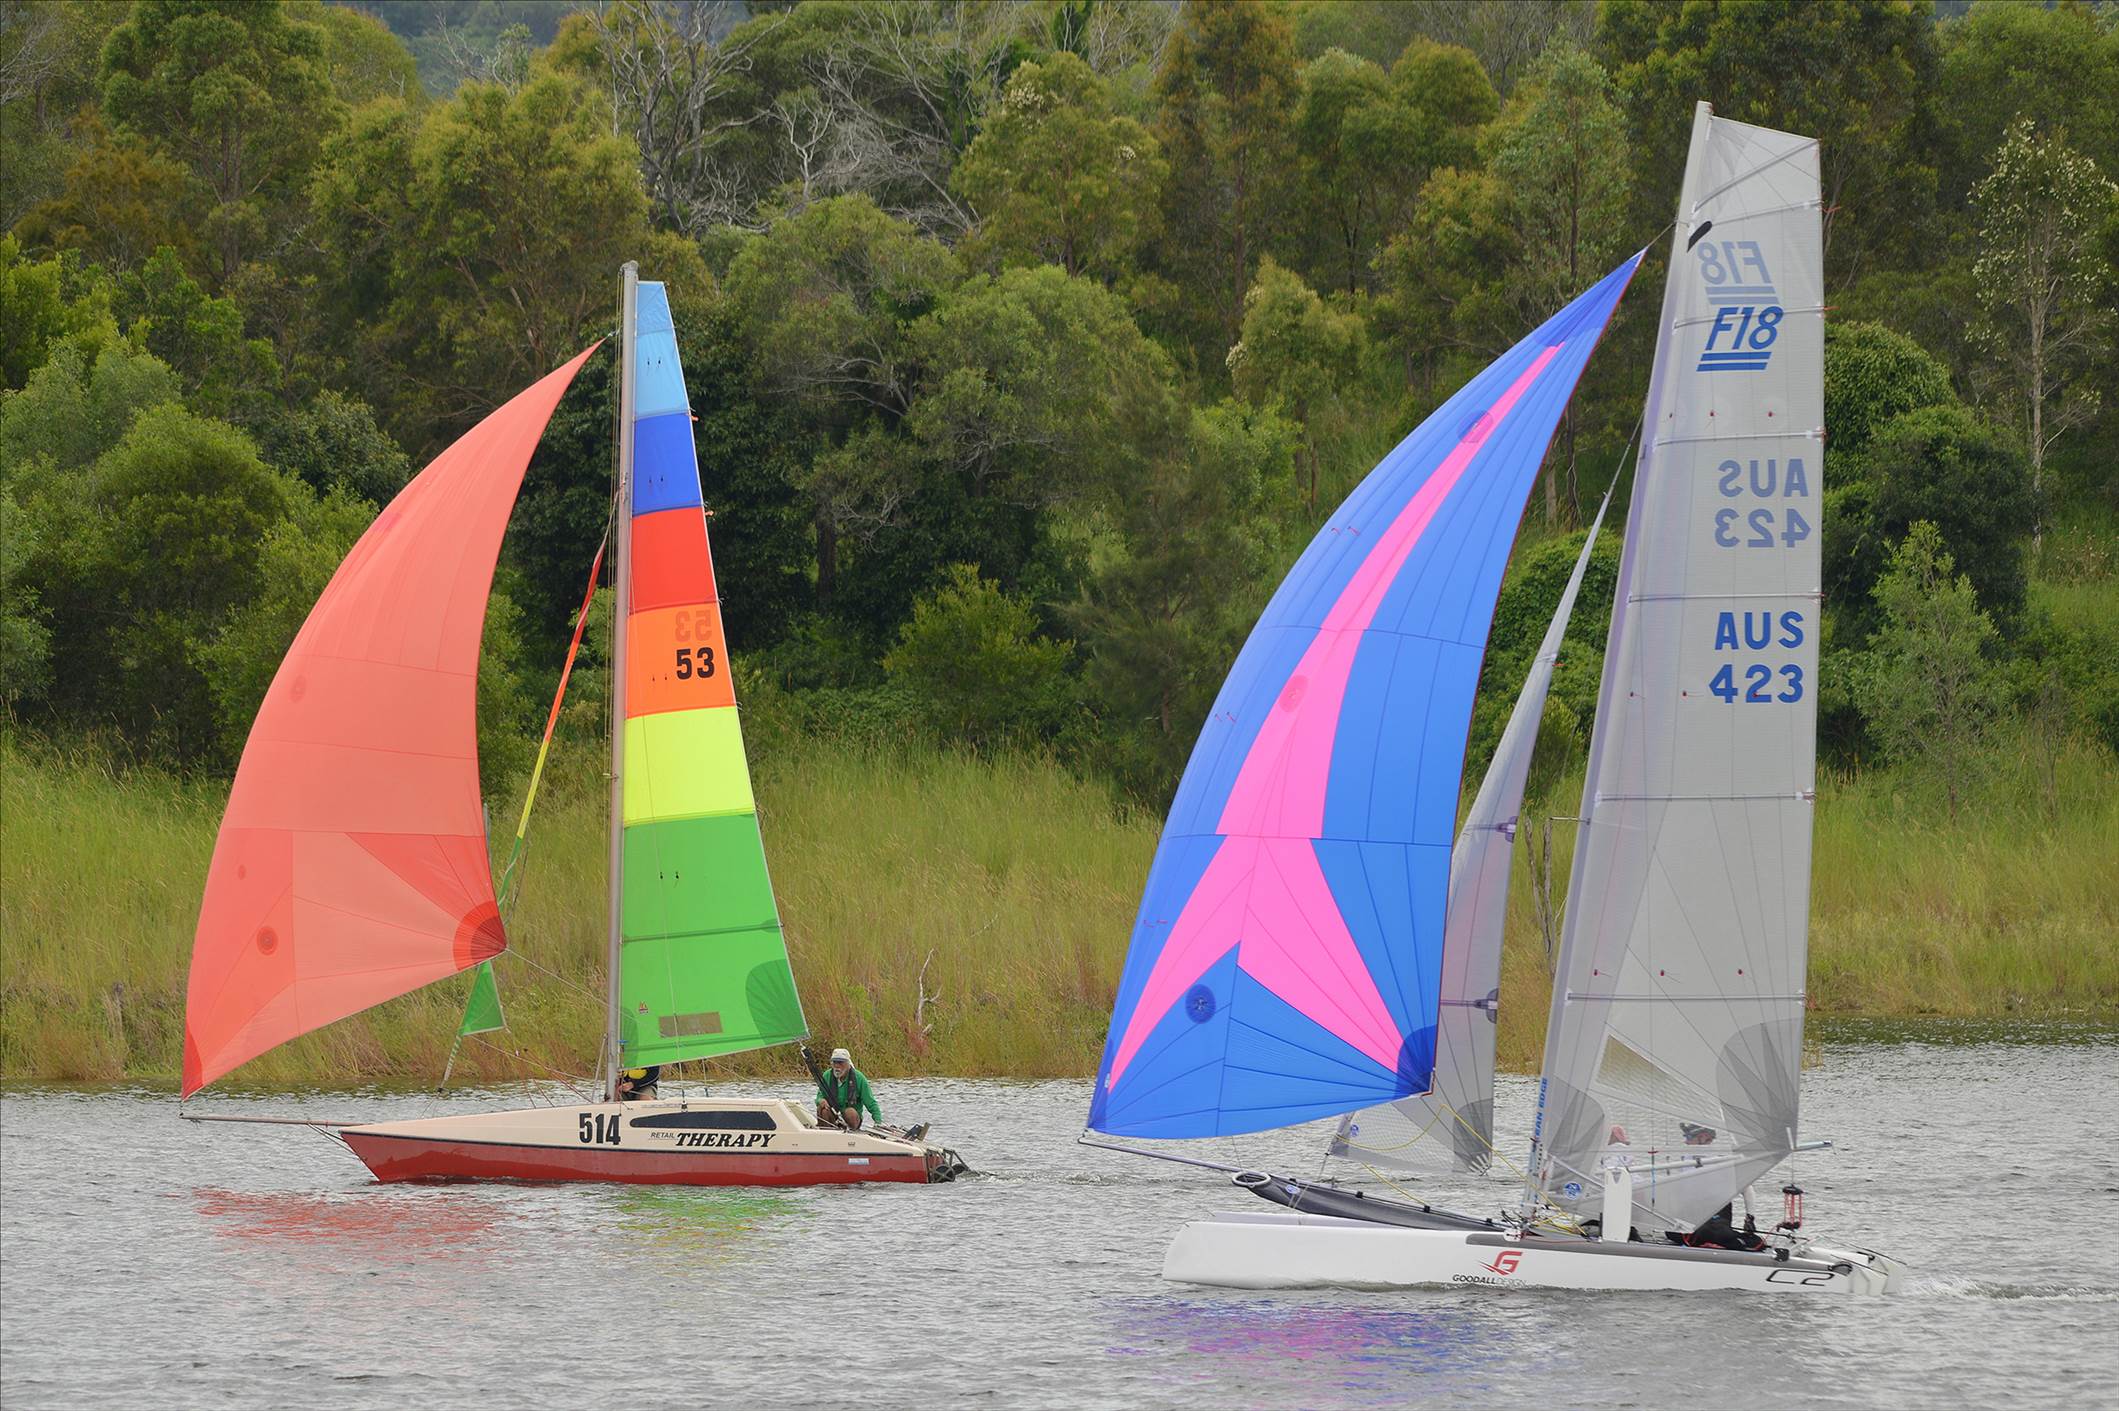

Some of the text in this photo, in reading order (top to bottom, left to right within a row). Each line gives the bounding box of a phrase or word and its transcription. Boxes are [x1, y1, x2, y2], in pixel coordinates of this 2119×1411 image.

[1705, 306, 1784, 350] F18
[1714, 611, 1804, 650] AUS
[676, 647, 715, 680] 53
[1708, 664, 1804, 704] 423
[579, 1112, 622, 1146] 514
[650, 1131, 777, 1148] RETAIL THERAPY
